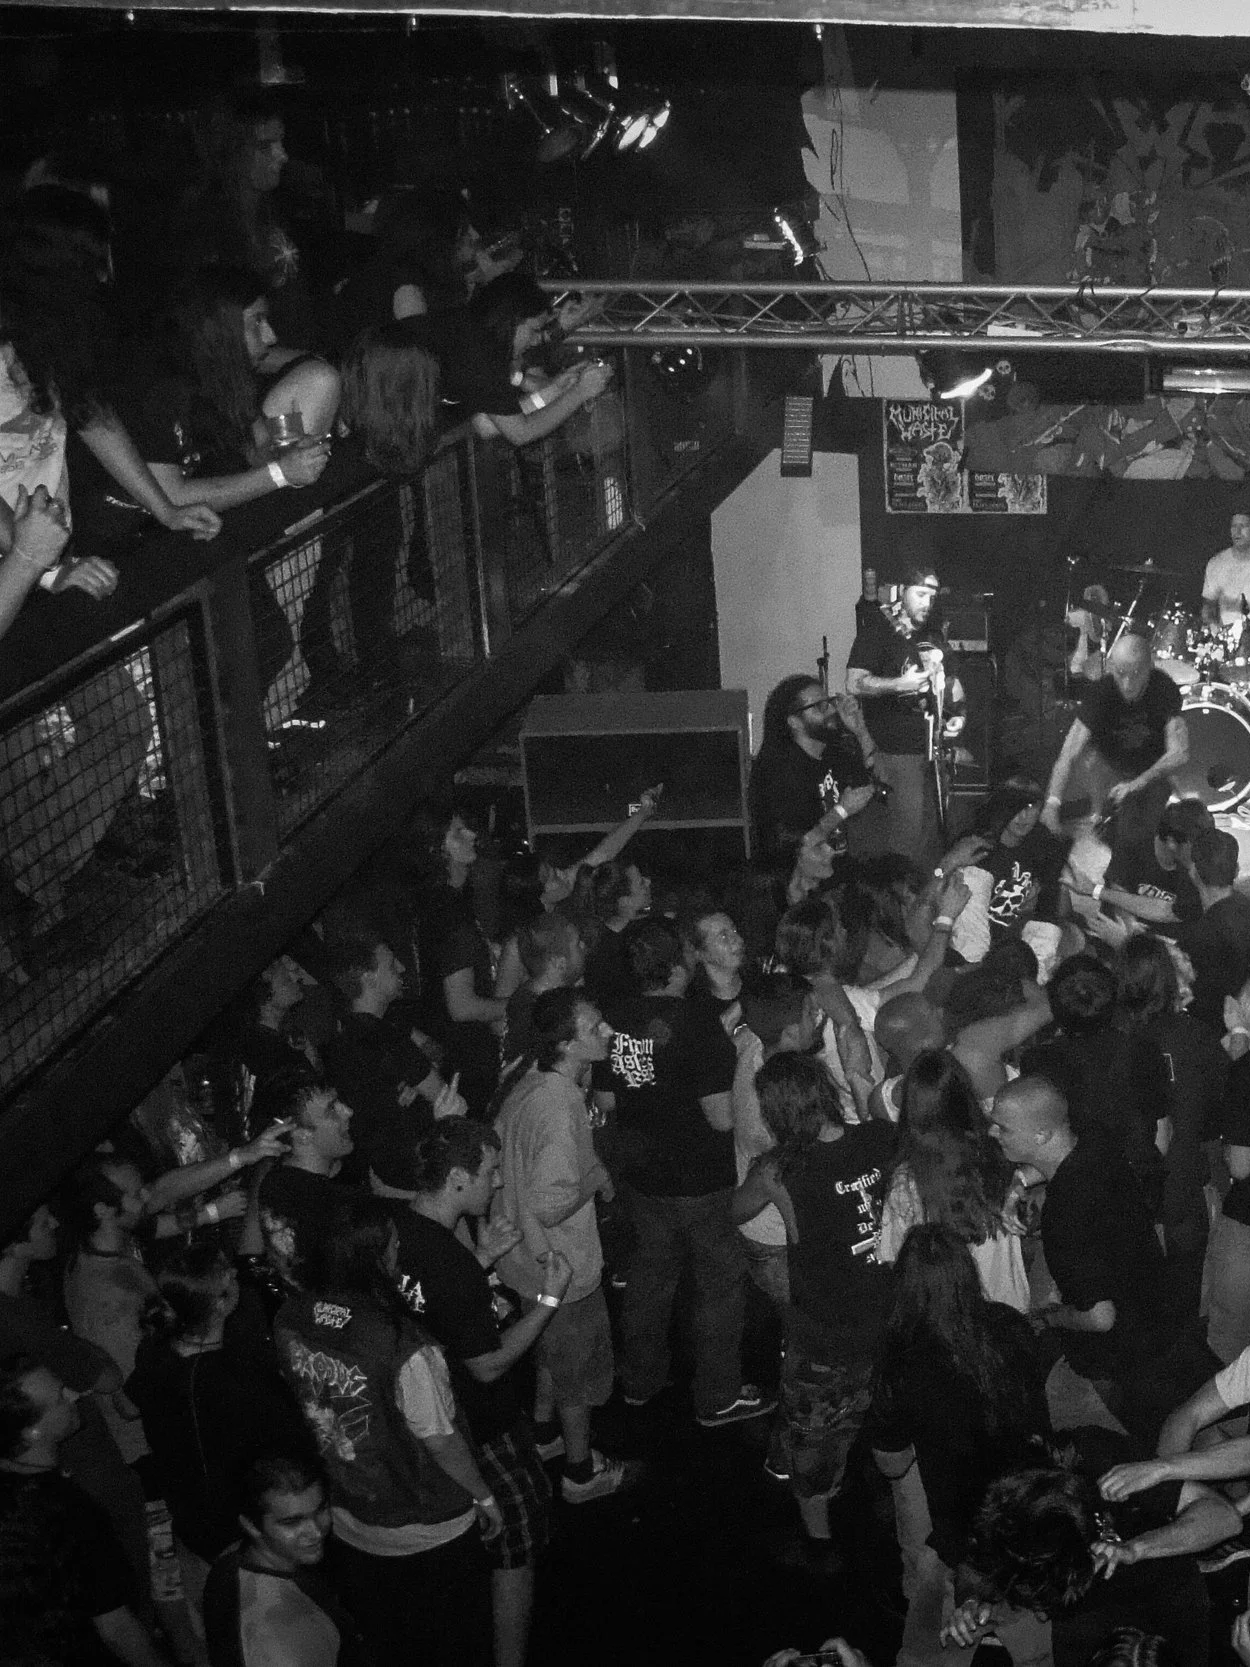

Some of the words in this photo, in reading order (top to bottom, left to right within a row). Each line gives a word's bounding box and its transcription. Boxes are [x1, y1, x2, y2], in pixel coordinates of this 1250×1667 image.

[889, 403, 959, 425] MUNICIPAL
[900, 421, 950, 441] WASTE
[611, 1032, 654, 1055] From
